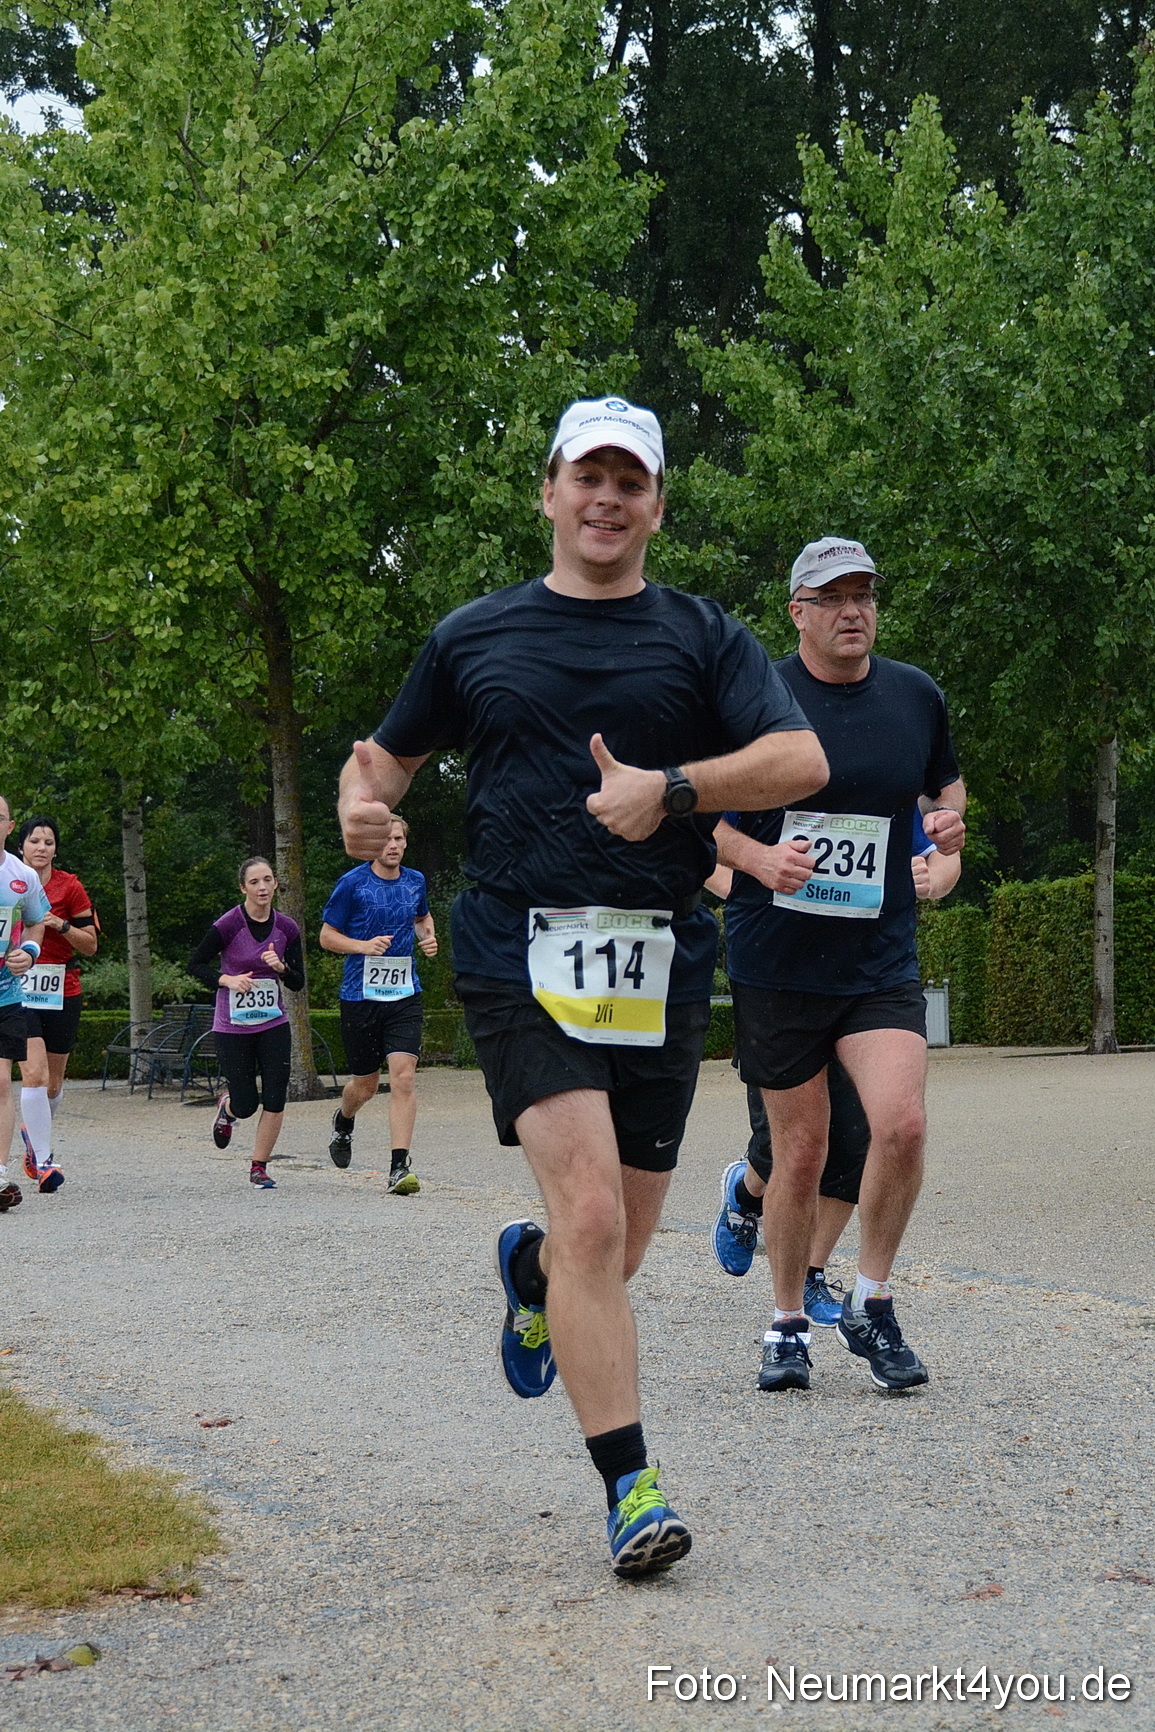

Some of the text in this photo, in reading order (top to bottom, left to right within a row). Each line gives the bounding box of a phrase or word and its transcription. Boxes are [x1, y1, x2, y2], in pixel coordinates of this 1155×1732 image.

[578, 416, 602, 427] BMW
[829, 818, 880, 833] BOCK
[791, 834, 876, 879] 234
[805, 883, 851, 903] Stefan
[563, 939, 645, 990] 114
[20, 974, 60, 992] 2109
[369, 968, 407, 985] 2761
[26, 994, 49, 1003] Sabine
[235, 990, 275, 1009] 2335
